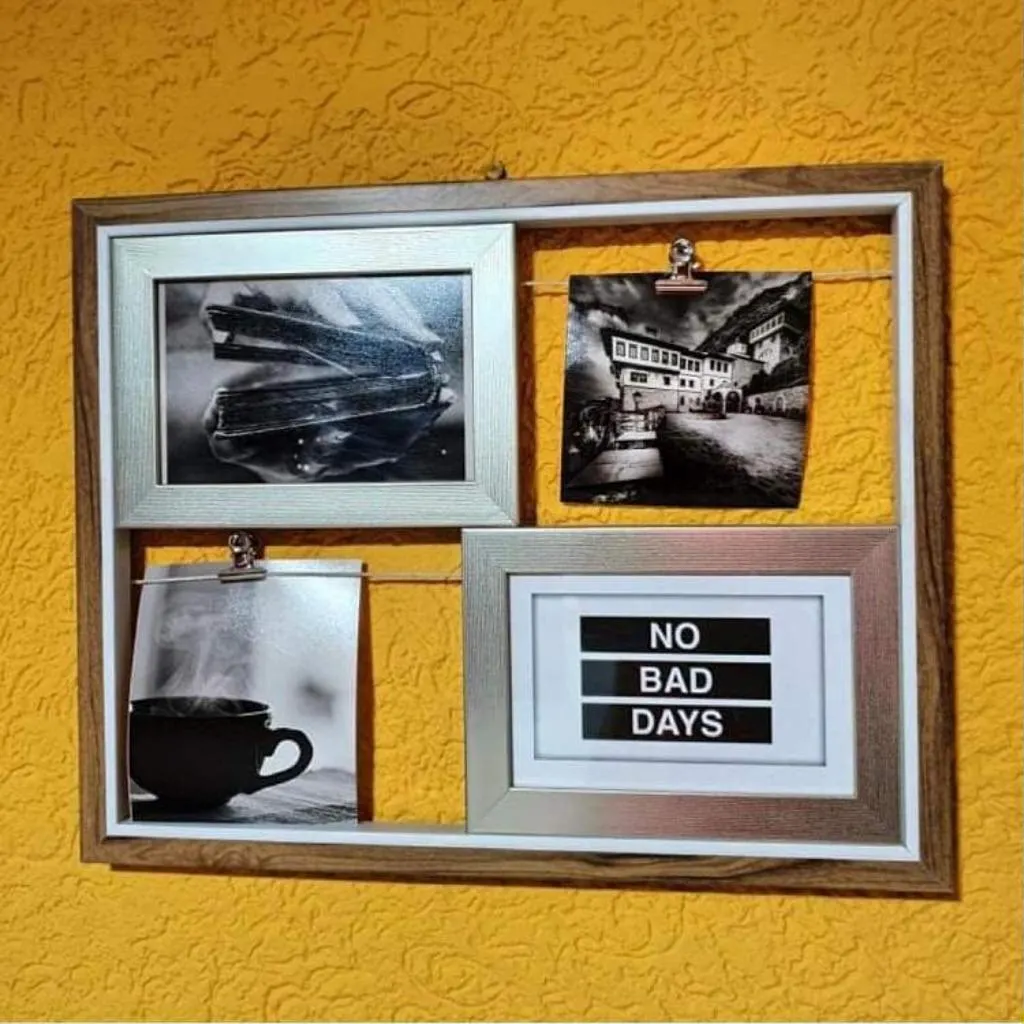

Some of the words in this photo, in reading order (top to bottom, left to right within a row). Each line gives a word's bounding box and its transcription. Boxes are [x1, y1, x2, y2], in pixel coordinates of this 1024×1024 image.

[649, 621, 701, 650] NO
[639, 666, 713, 694] BAD
[631, 707, 724, 738] DAYS
